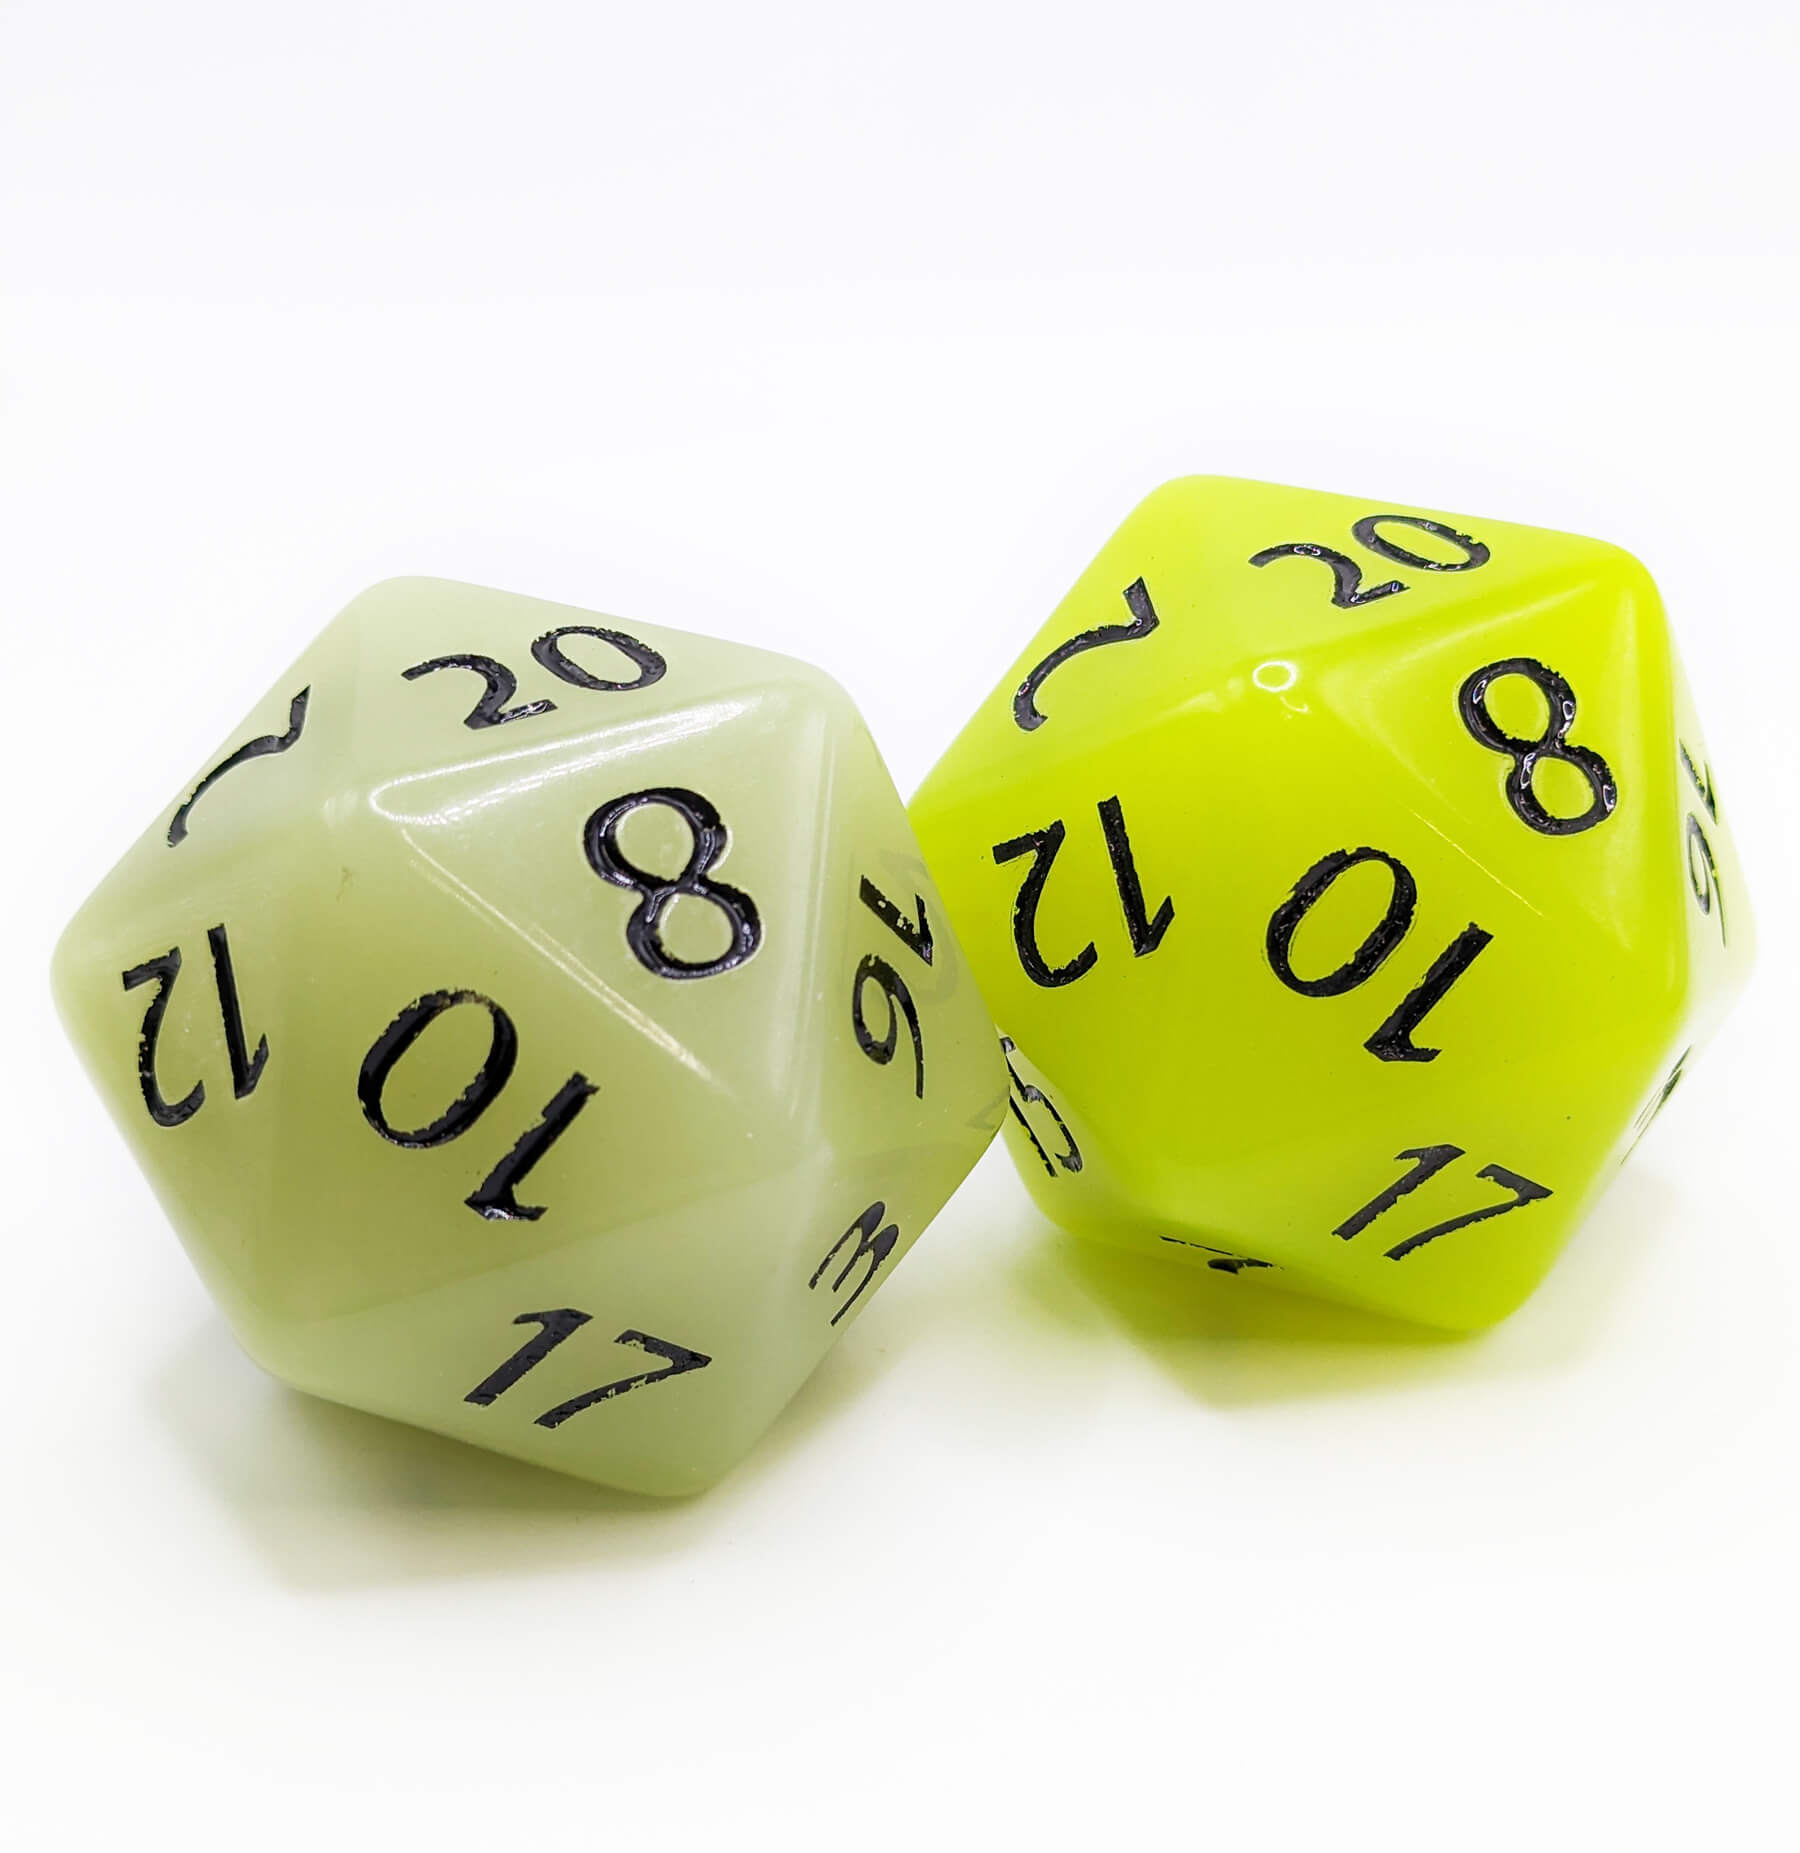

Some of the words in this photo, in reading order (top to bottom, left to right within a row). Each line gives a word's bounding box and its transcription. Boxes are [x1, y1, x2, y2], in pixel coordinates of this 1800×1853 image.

[1250, 515, 1491, 609] 20
[402, 625, 667, 730] 20
[1458, 657, 1618, 836] 8
[582, 786, 762, 980] 8
[992, 795, 1176, 988] 12
[1265, 846, 1494, 1063] 10
[121, 923, 270, 1128] 12
[851, 874, 934, 1100] 16
[355, 988, 601, 1222] 10
[808, 1201, 900, 1327] 3
[1331, 1143, 1554, 1262] 17
[462, 1307, 713, 1430] 17
